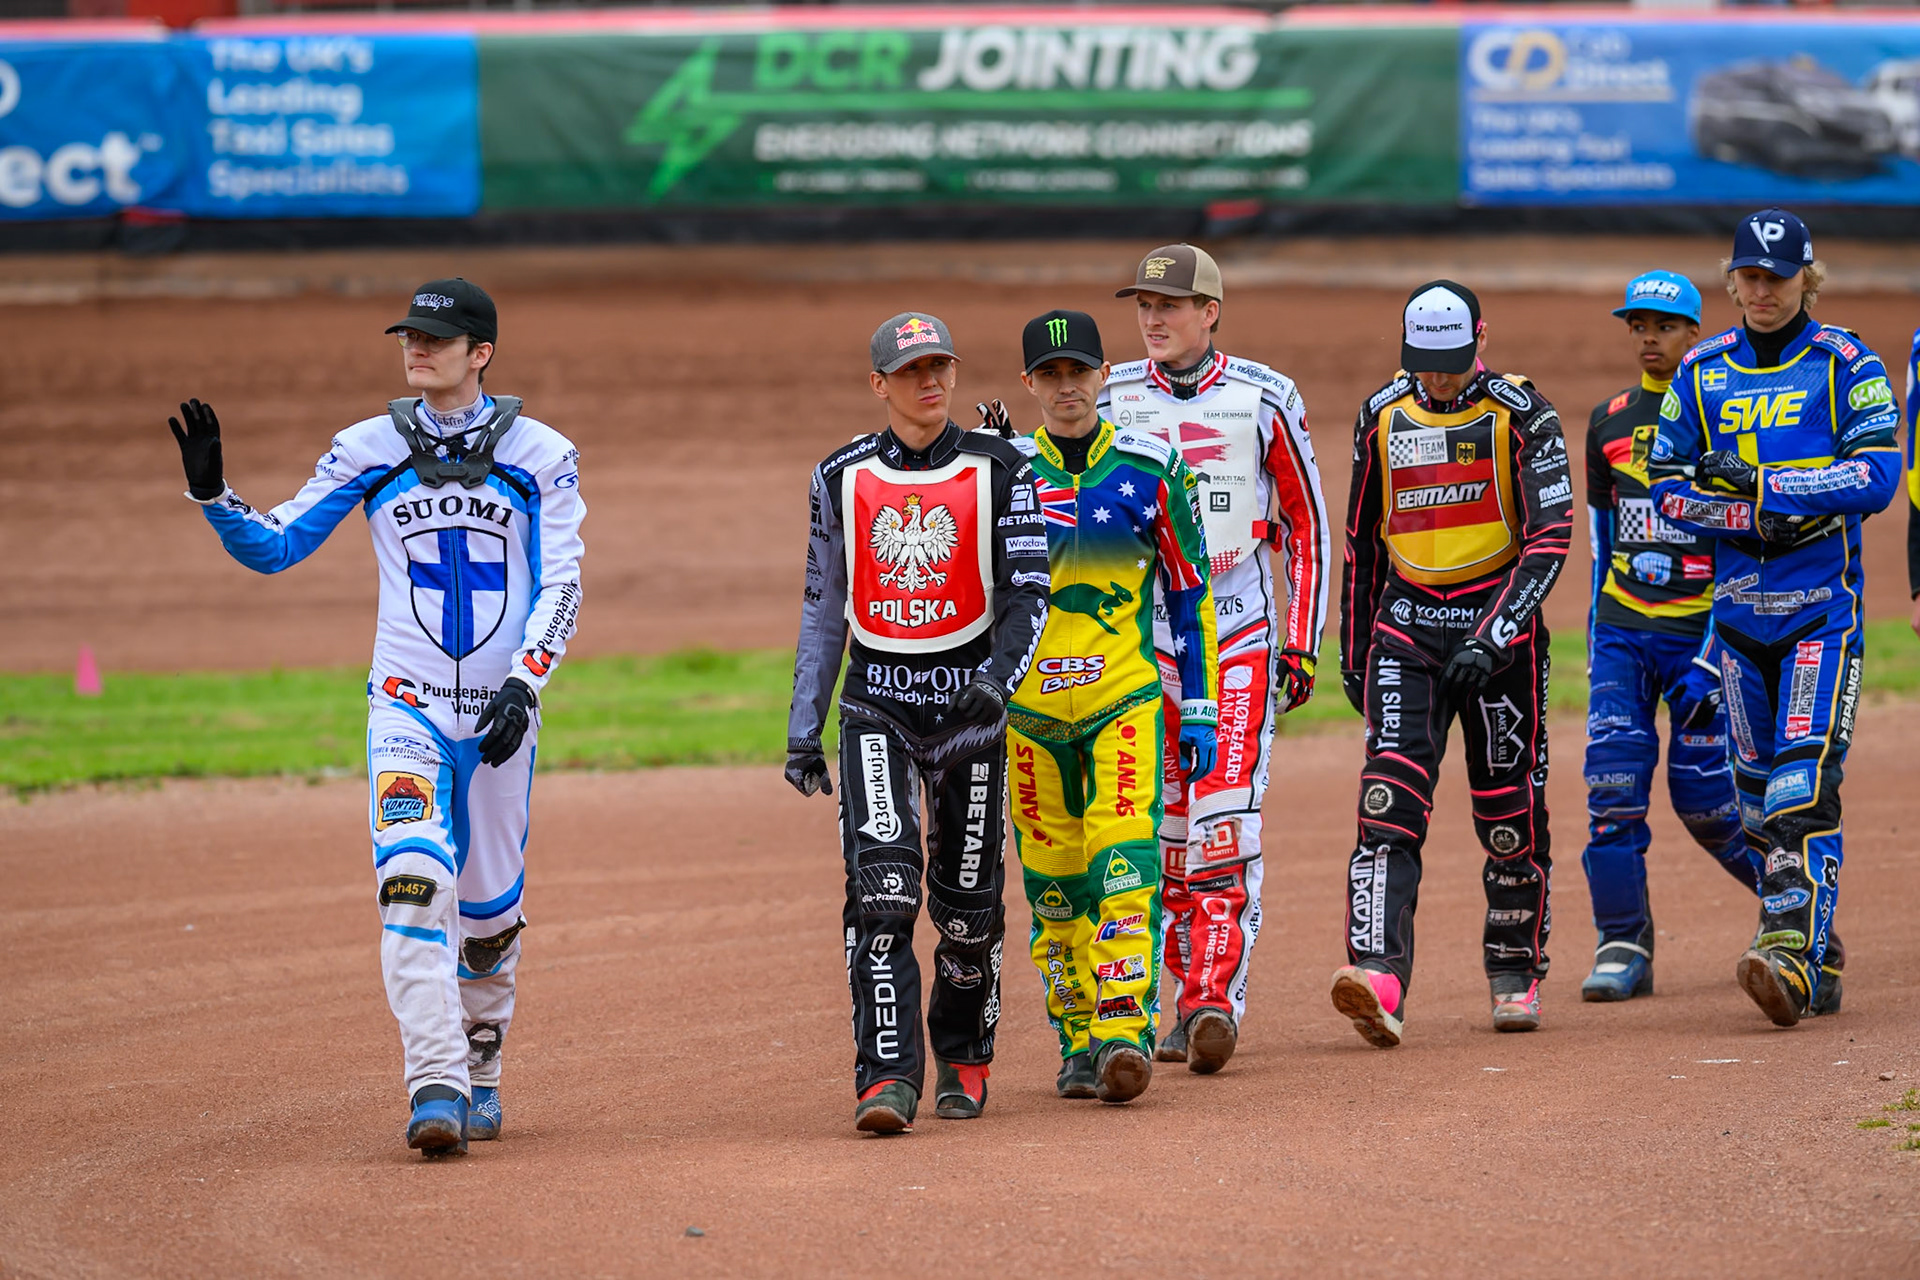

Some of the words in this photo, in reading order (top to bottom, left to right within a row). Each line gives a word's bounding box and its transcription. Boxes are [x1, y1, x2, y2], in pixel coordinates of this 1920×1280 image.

[208, 38, 281, 72] The
[753, 30, 912, 90] DCR
[918, 26, 1261, 91] JOINTING
[207, 80, 363, 124] Leading
[291, 121, 395, 157] Sales
[207, 162, 409, 200] Specialists
[1633, 280, 1681, 296] MHR
[897, 333, 919, 350] Red
[919, 332, 940, 344] Bull
[1426, 323, 1463, 332] SULPHTEC
[1369, 378, 1410, 407] mario
[1734, 387, 1772, 396] SPEEDWAY
[1774, 384, 1794, 393] TEAM
[1719, 390, 1807, 434] SWE
[1420, 442, 1445, 454] TEAM
[1420, 454, 1446, 463] GERMANY
[1212, 494, 1228, 506] ID
[1396, 481, 1489, 510] GERMANY
[1538, 474, 1571, 503] mari
[393, 495, 514, 528] SUOMI
[997, 513, 1047, 527] BETARD
[1508, 577, 1538, 614] Autohaus
[868, 599, 957, 628] POLSKA
[1038, 655, 1106, 675] CBS
[1040, 670, 1102, 695] BINS
[1840, 657, 1862, 731] SPÅNGA
[451, 700, 486, 716] Vuol
[1376, 691, 1402, 750] Trans
[1225, 691, 1250, 785] NØRGAARD
[866, 736, 893, 838] 123drukuj.pl
[1017, 743, 1042, 822] ANLAS
[1116, 750, 1137, 818] ANLAS
[385, 799, 422, 811] KONTIO
[958, 784, 987, 889] BETARD
[1105, 879, 1143, 893] AUSTRALIA
[1117, 914, 1144, 928] SPORT
[1374, 881, 1385, 954] Fahrschule
[1217, 923, 1230, 955] OTTO
[1098, 958, 1129, 977] EK
